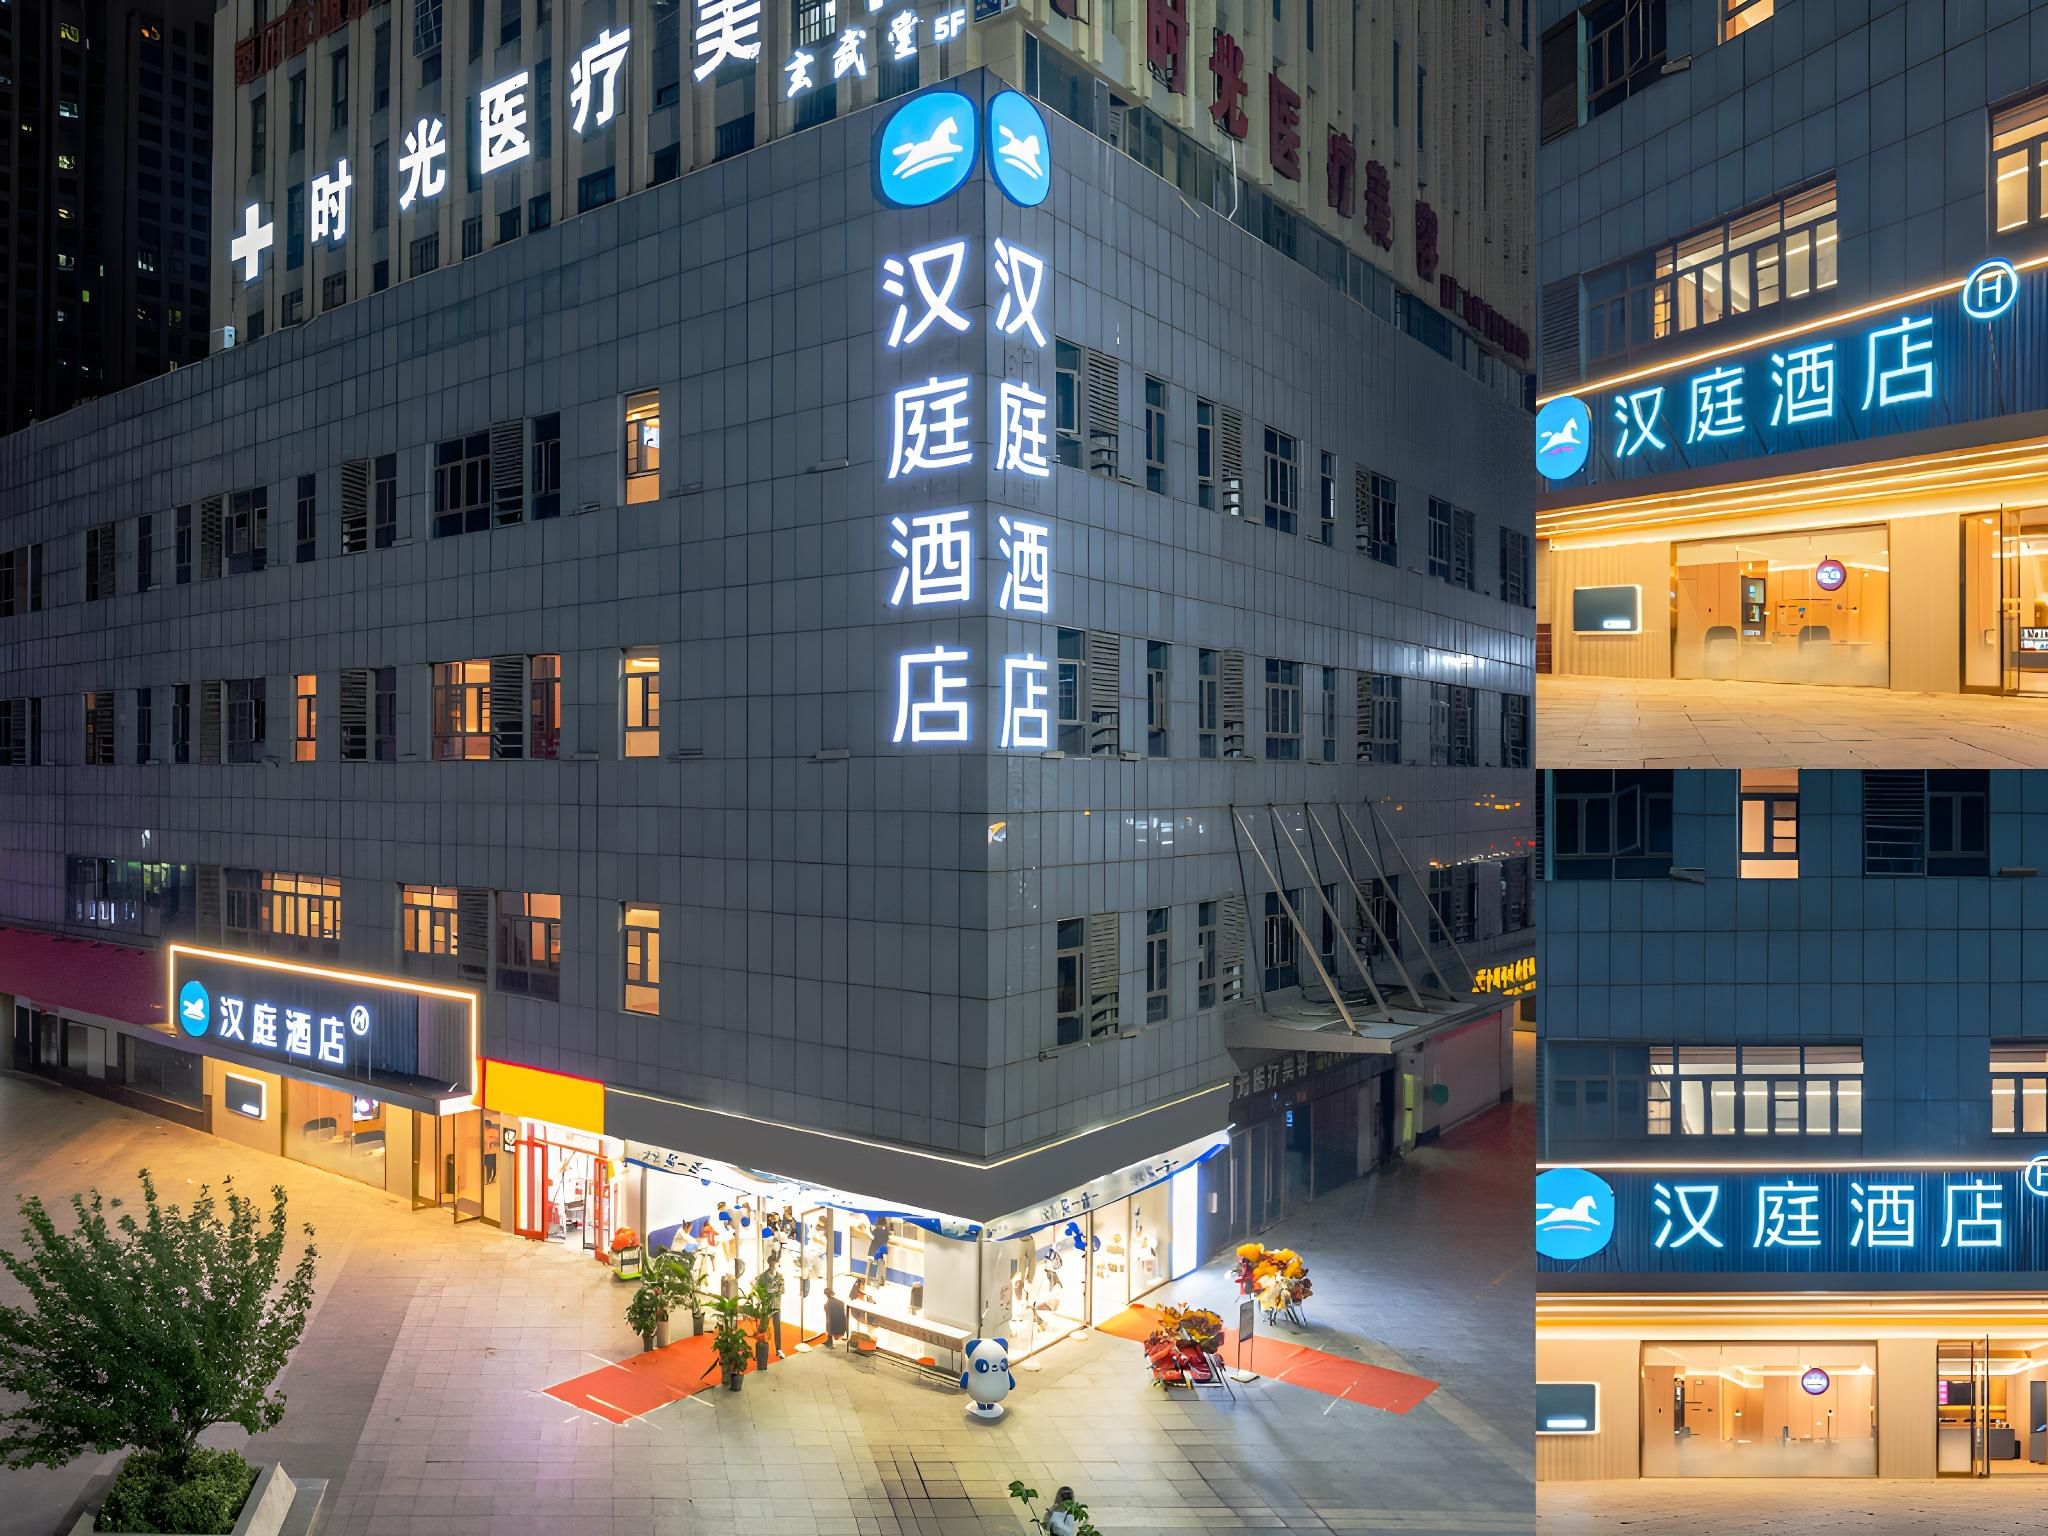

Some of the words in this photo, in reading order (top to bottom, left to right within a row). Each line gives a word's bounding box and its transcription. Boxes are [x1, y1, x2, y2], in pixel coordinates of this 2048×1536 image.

[933, 8, 966, 42] 5F
[310, 0, 884, 244] 时光医疗美
[1613, 316, 1935, 459] 汉庭酒店
[882, 241, 973, 743] 汉庭酒店
[994, 237, 1049, 748] 汉庭酒店
[218, 995, 346, 1064] 汉庭酒店
[1652, 1179, 2005, 1249] 汉庭酒店
